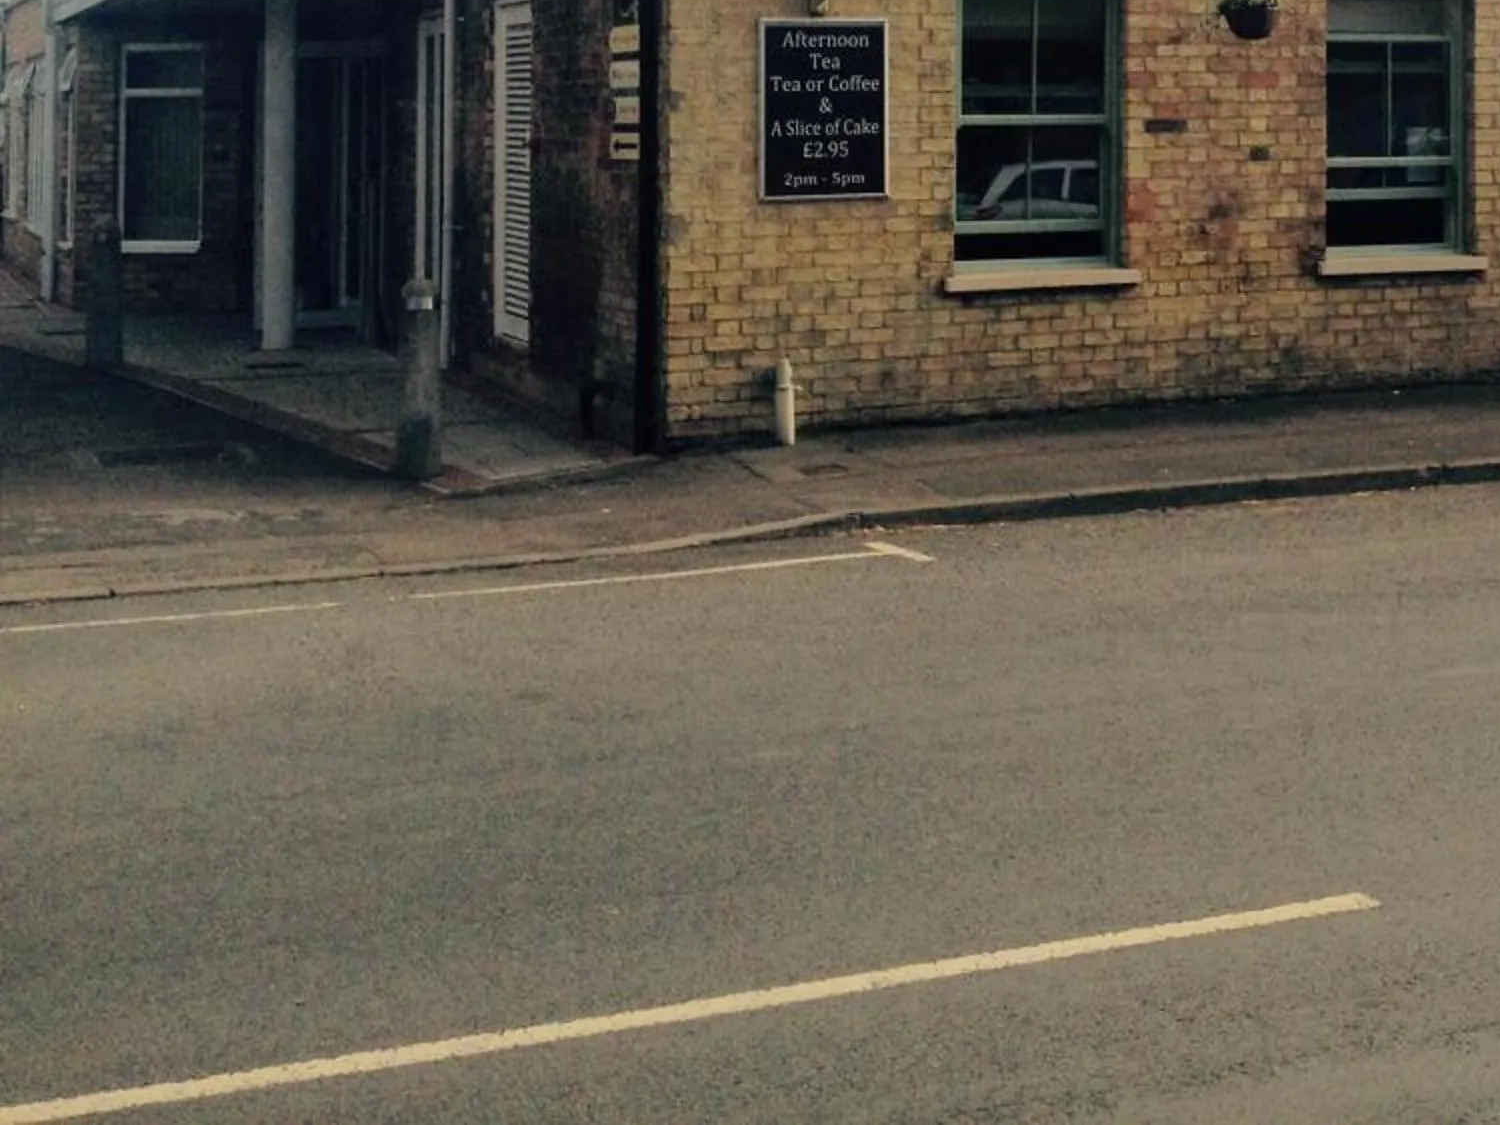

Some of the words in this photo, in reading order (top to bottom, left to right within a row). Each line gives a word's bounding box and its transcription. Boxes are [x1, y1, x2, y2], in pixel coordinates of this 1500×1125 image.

[783, 30, 869, 48] Afternoon
[810, 53, 841, 70] Tea
[770, 76, 801, 92] Tea
[806, 80, 824, 92] or
[829, 75, 880, 92] Coffee
[819, 96, 833, 114] &
[771, 120, 782, 137] A
[787, 119, 820, 136] Slice
[825, 118, 840, 136] of
[843, 118, 879, 135] Cake
[803, 141, 849, 158] £2.95
[784, 173, 818, 188] 2pm
[832, 173, 865, 187] 5pm
